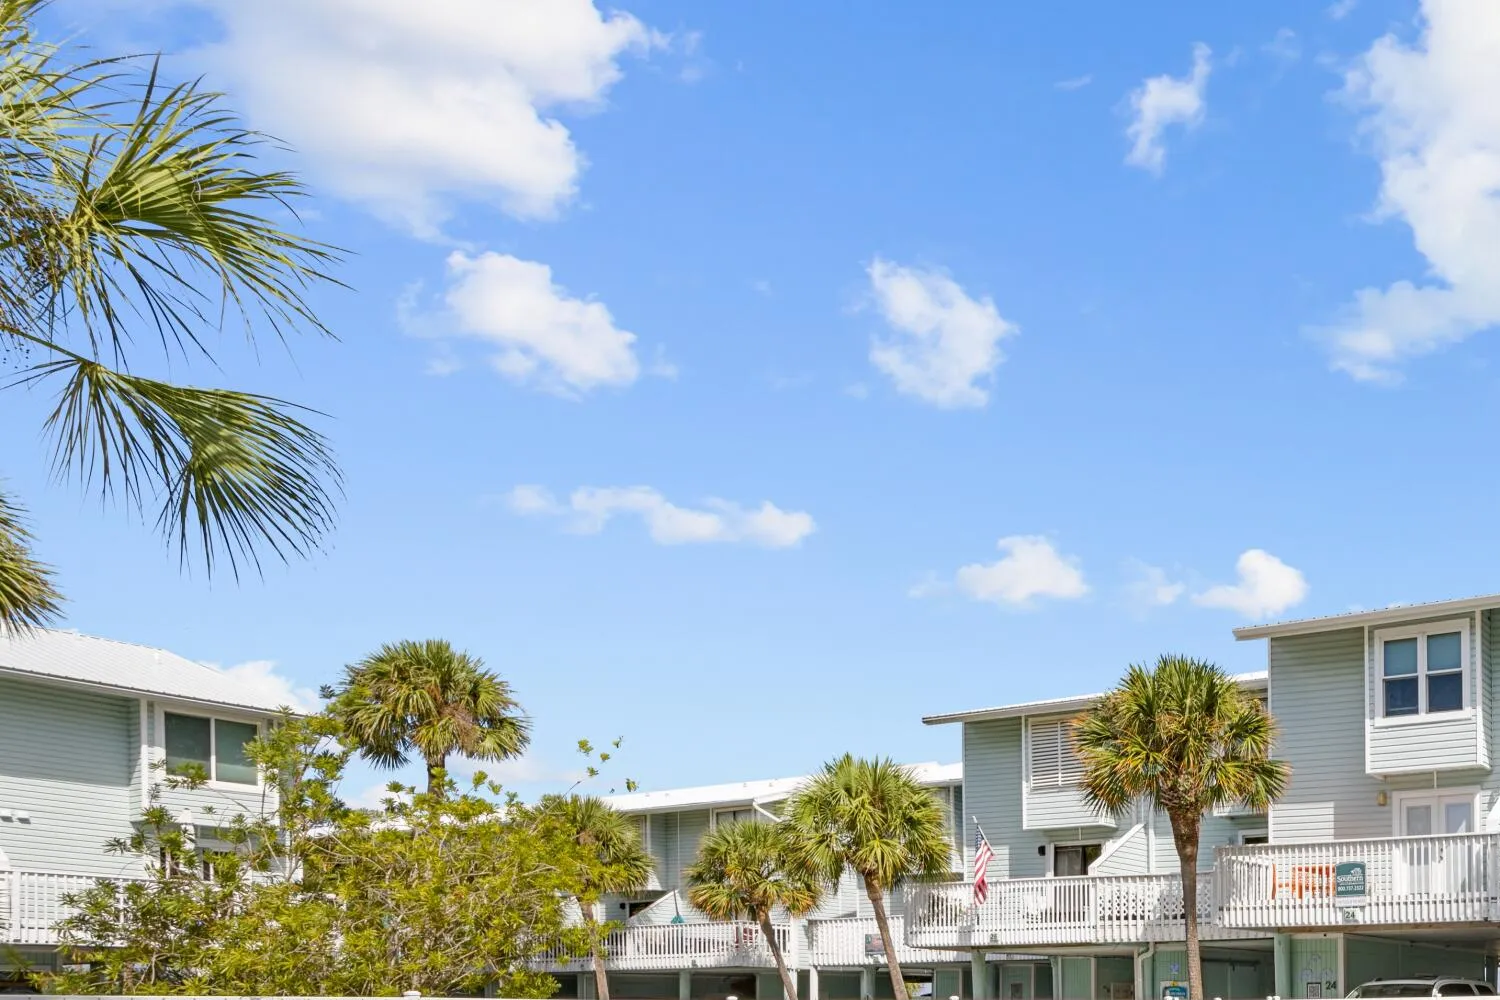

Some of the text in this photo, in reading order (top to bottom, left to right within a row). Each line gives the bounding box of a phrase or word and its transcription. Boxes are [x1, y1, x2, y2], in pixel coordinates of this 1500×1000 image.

[1336, 874, 1364, 882] Southern
[1345, 911, 1355, 919] 24
[1325, 980, 1337, 990] 24
